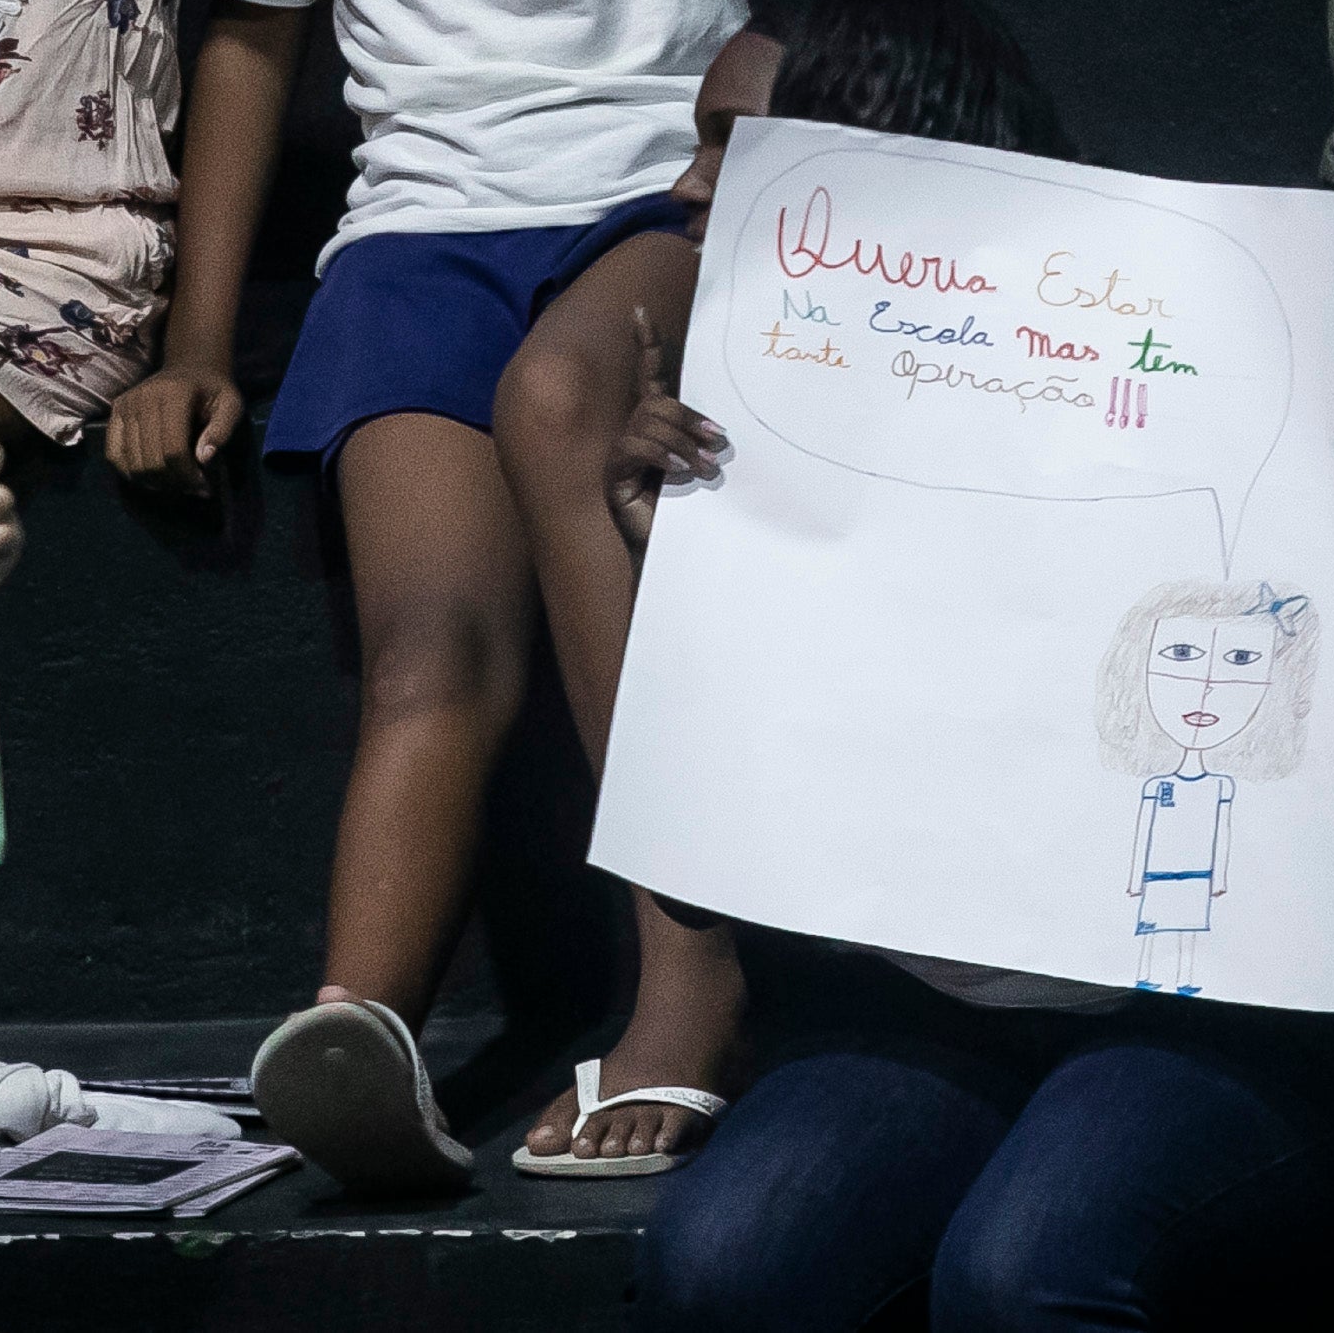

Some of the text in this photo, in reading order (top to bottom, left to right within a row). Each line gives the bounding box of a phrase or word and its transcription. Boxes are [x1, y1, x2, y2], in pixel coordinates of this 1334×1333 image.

[777, 186, 1173, 319] Queria Estar
[781, 289, 841, 327] Na
[868, 300, 995, 348] Escola
[1127, 327, 1199, 377] tem
